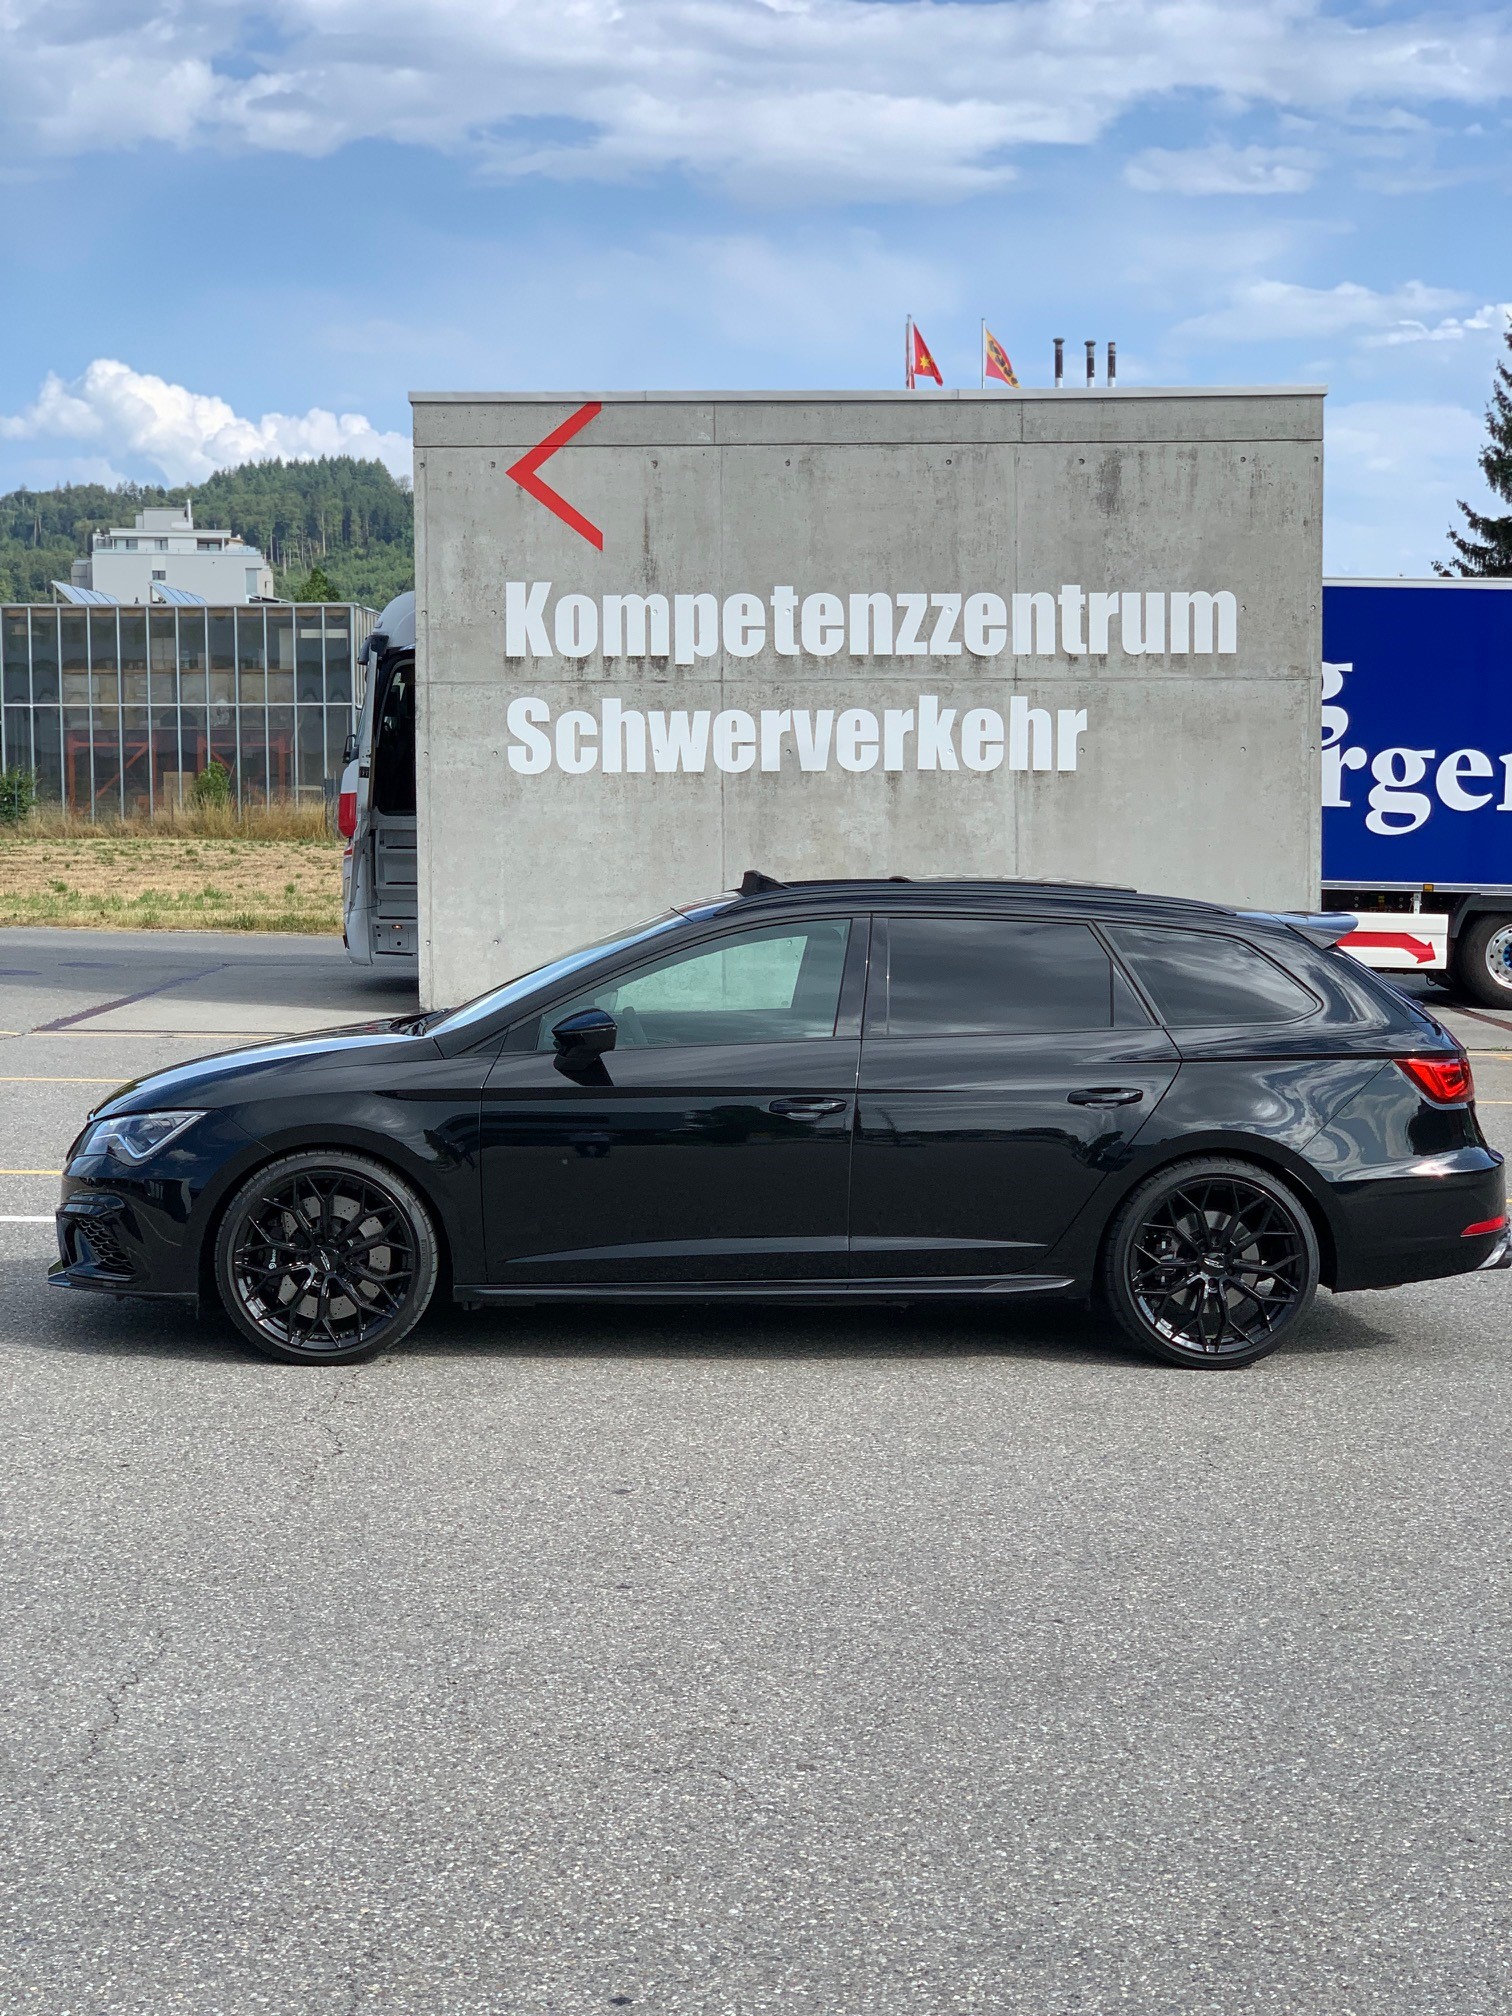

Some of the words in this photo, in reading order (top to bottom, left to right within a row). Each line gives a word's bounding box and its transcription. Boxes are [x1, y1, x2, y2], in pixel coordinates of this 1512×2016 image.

[505, 581, 1237, 665] Kompetenzzentrum
[506, 694, 1089, 775] Schwerverkehr
[1322, 742, 1512, 836] rge
